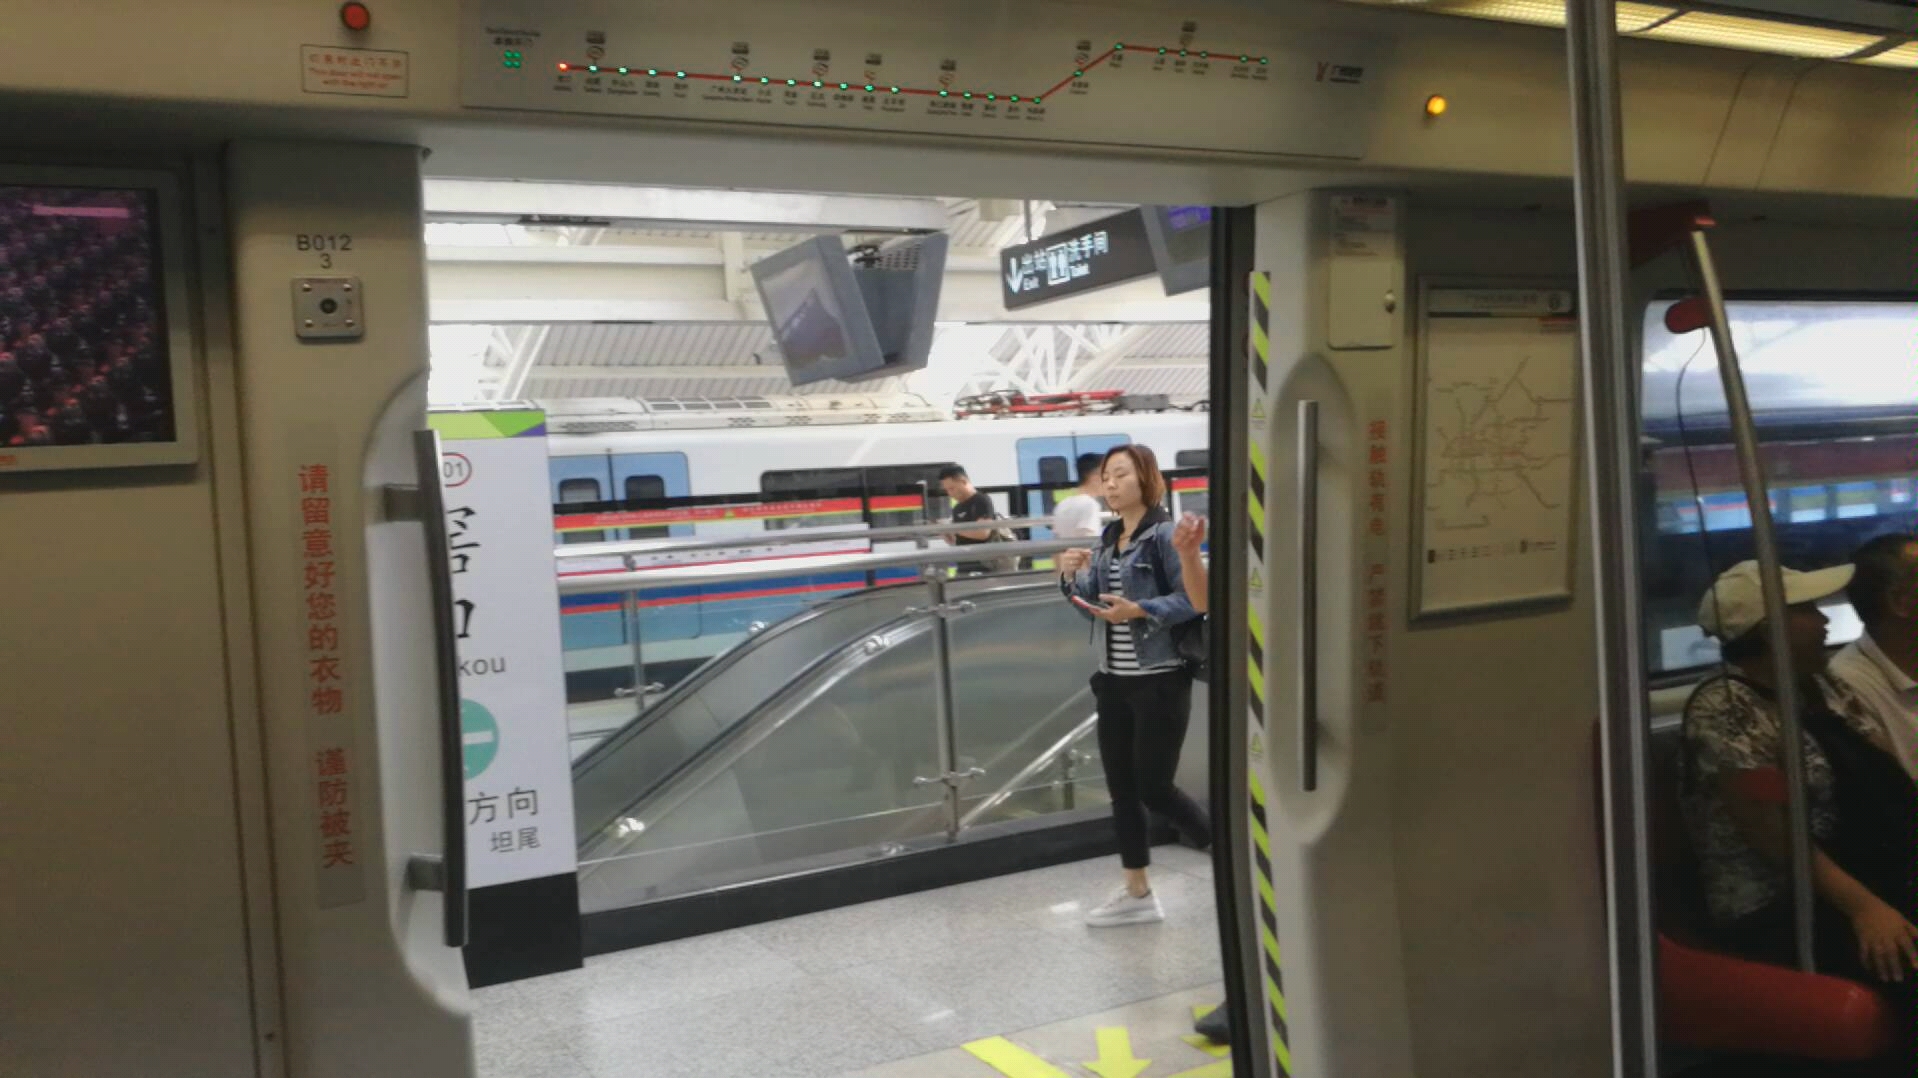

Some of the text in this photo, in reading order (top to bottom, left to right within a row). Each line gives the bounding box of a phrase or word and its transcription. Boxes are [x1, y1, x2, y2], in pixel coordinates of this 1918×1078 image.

[296, 234, 352, 251] B012
[320, 253, 333, 269] 3
[298, 464, 356, 870] 请留意好您的衣物 谨防被夹
[467, 786, 539, 826] 方向
[488, 826, 542, 854] 坦尾
